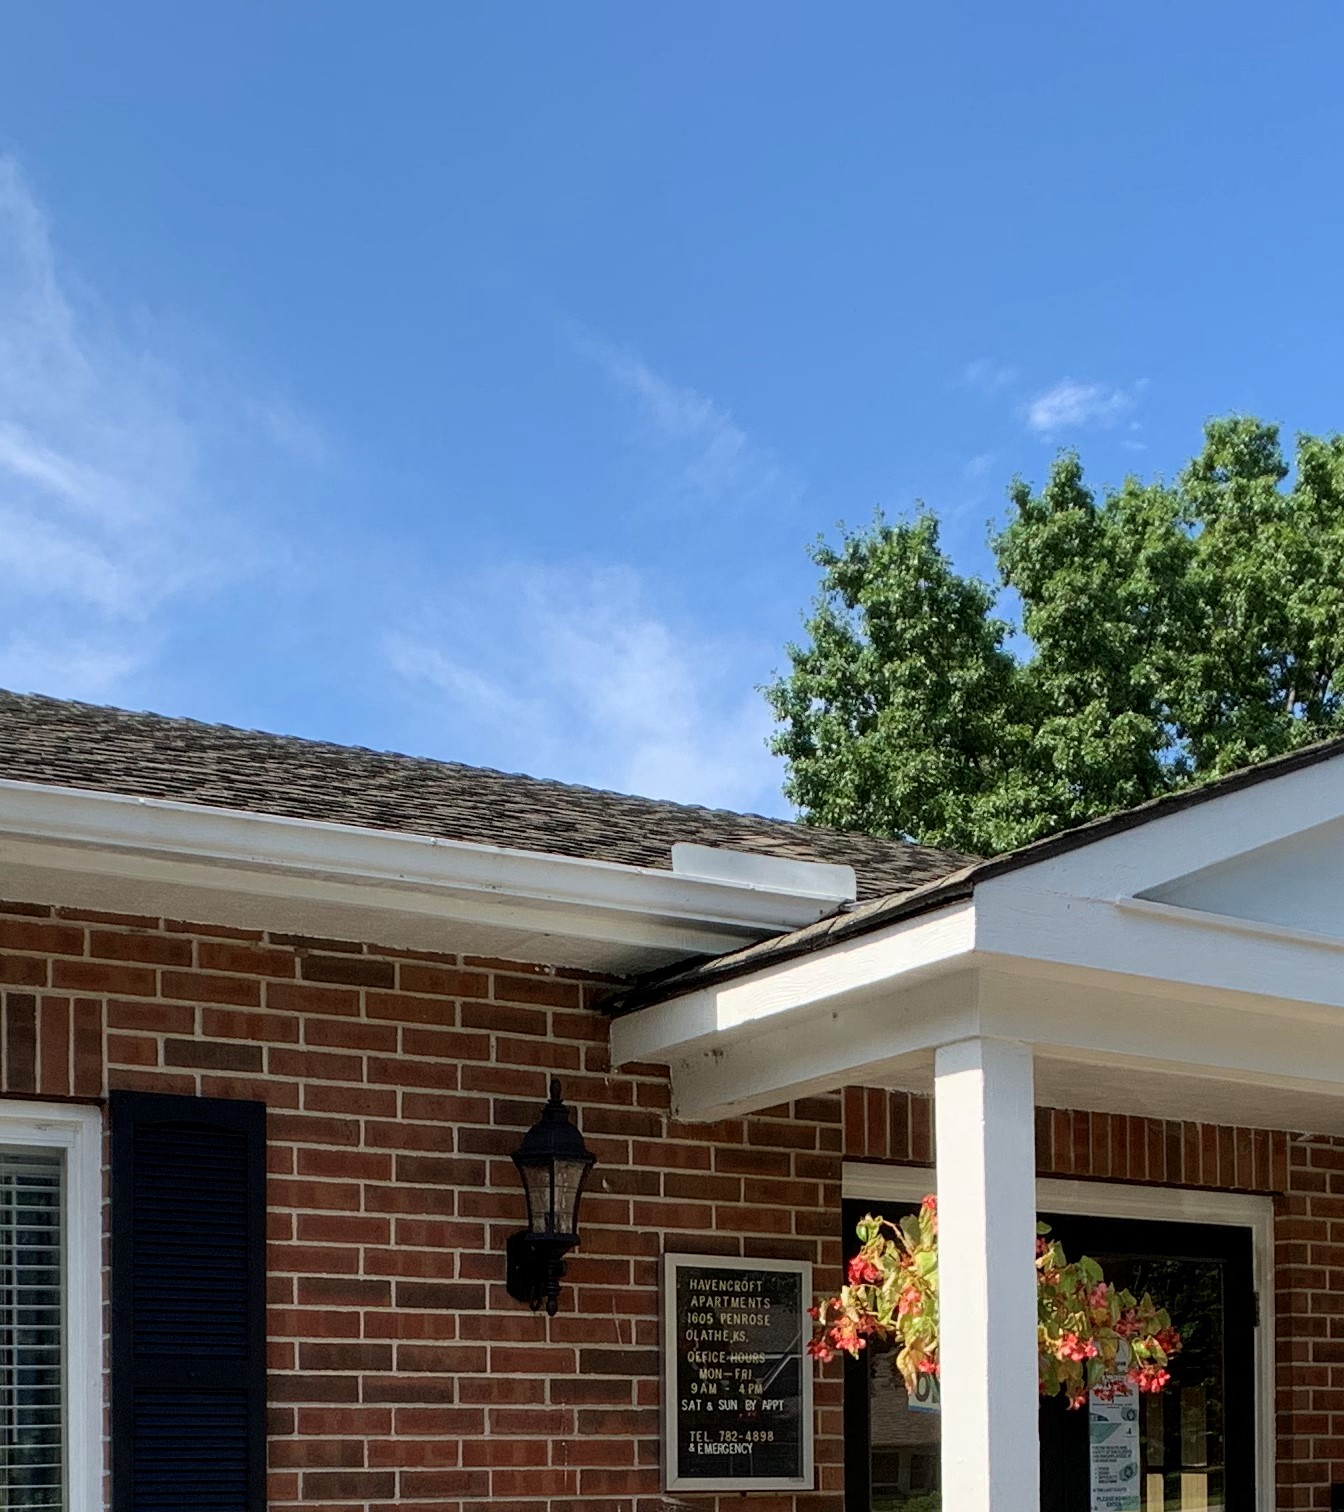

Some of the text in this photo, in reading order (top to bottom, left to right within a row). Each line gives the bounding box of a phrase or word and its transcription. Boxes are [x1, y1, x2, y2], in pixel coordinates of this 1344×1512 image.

[689, 1279, 763, 1292] HAVENCROFT
[690, 1295, 771, 1309] APARTMENTS
[687, 1312, 771, 1326] 1605 PENROSE
[687, 1350, 765, 1364] OFFICE HOURS
[681, 1399, 785, 1412] SAT & SUN BY APPT
[718, 1430, 775, 1442] 782-4898
[688, 1443, 754, 1455] & EMERGENCY
